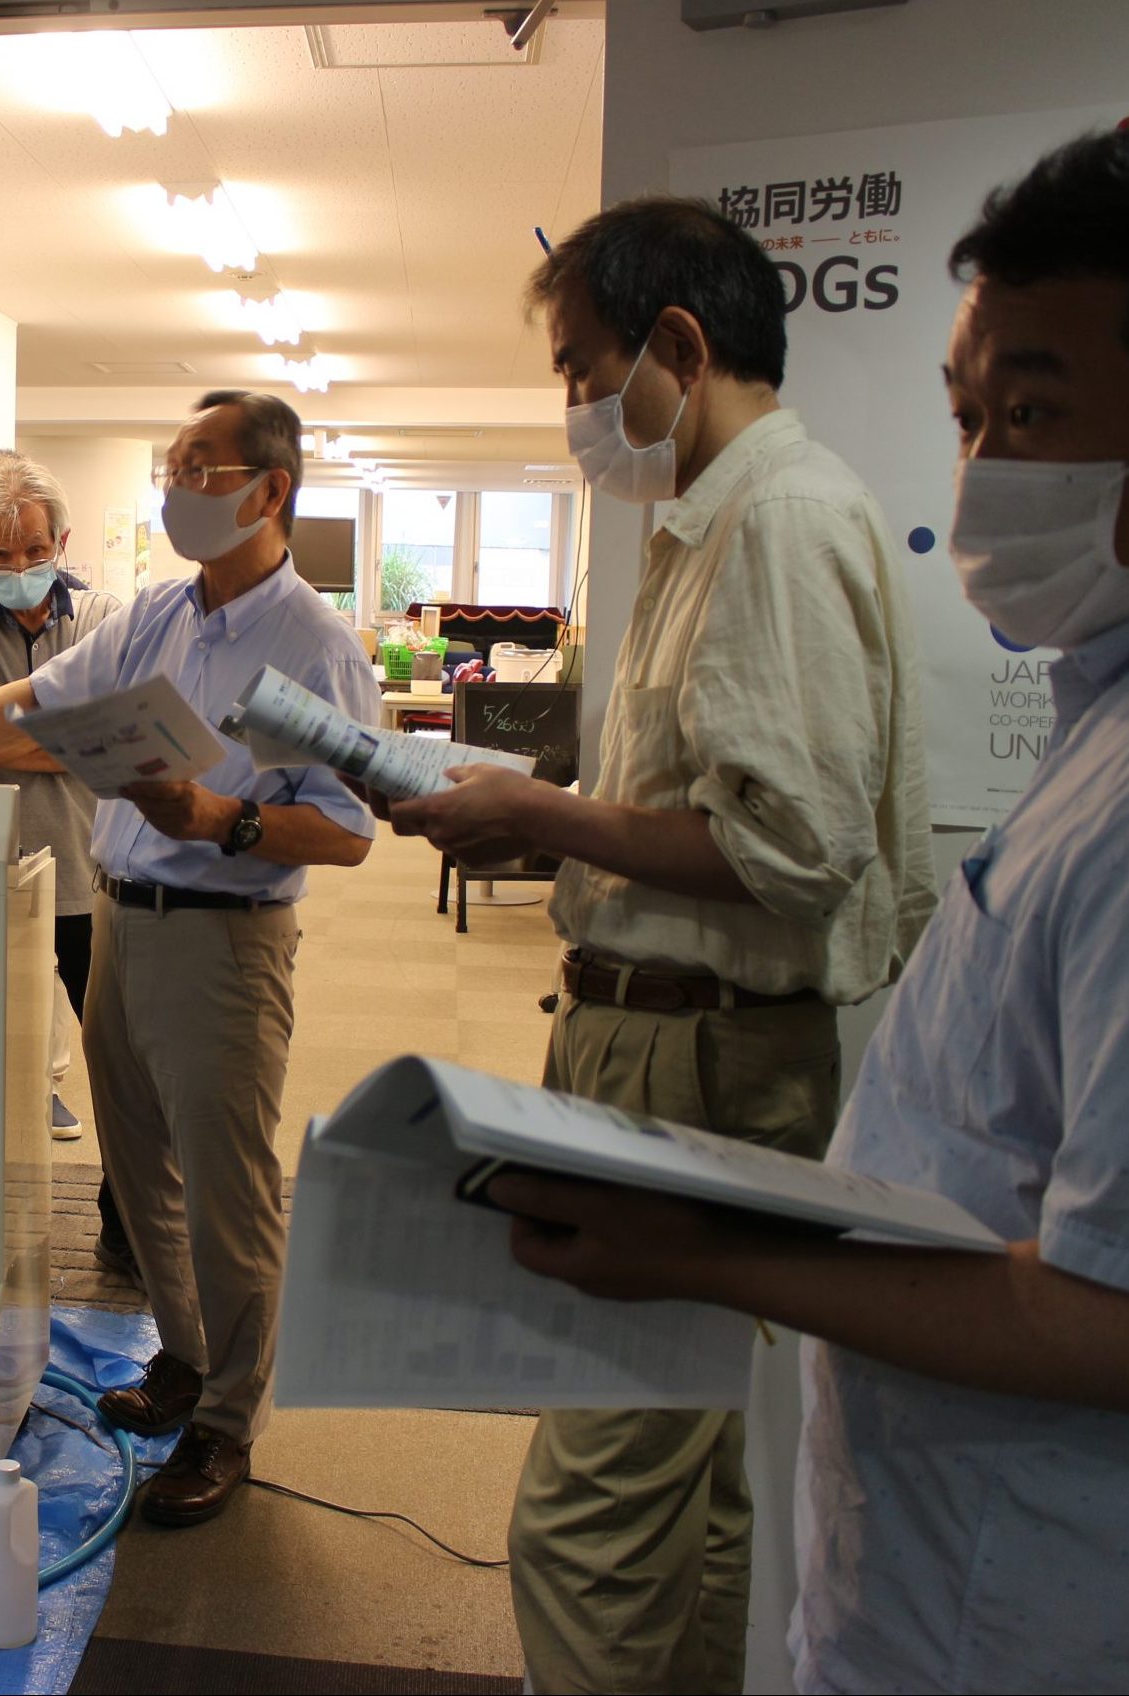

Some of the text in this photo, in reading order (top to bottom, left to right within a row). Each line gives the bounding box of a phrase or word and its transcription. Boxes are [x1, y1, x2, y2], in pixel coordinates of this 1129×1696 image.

[718, 171, 902, 229] 協同労働
[759, 235, 804, 252] の未来
[990, 659, 1051, 685] JAP
[990, 690, 1054, 710] WORK
[989, 731, 1048, 761] UNI
